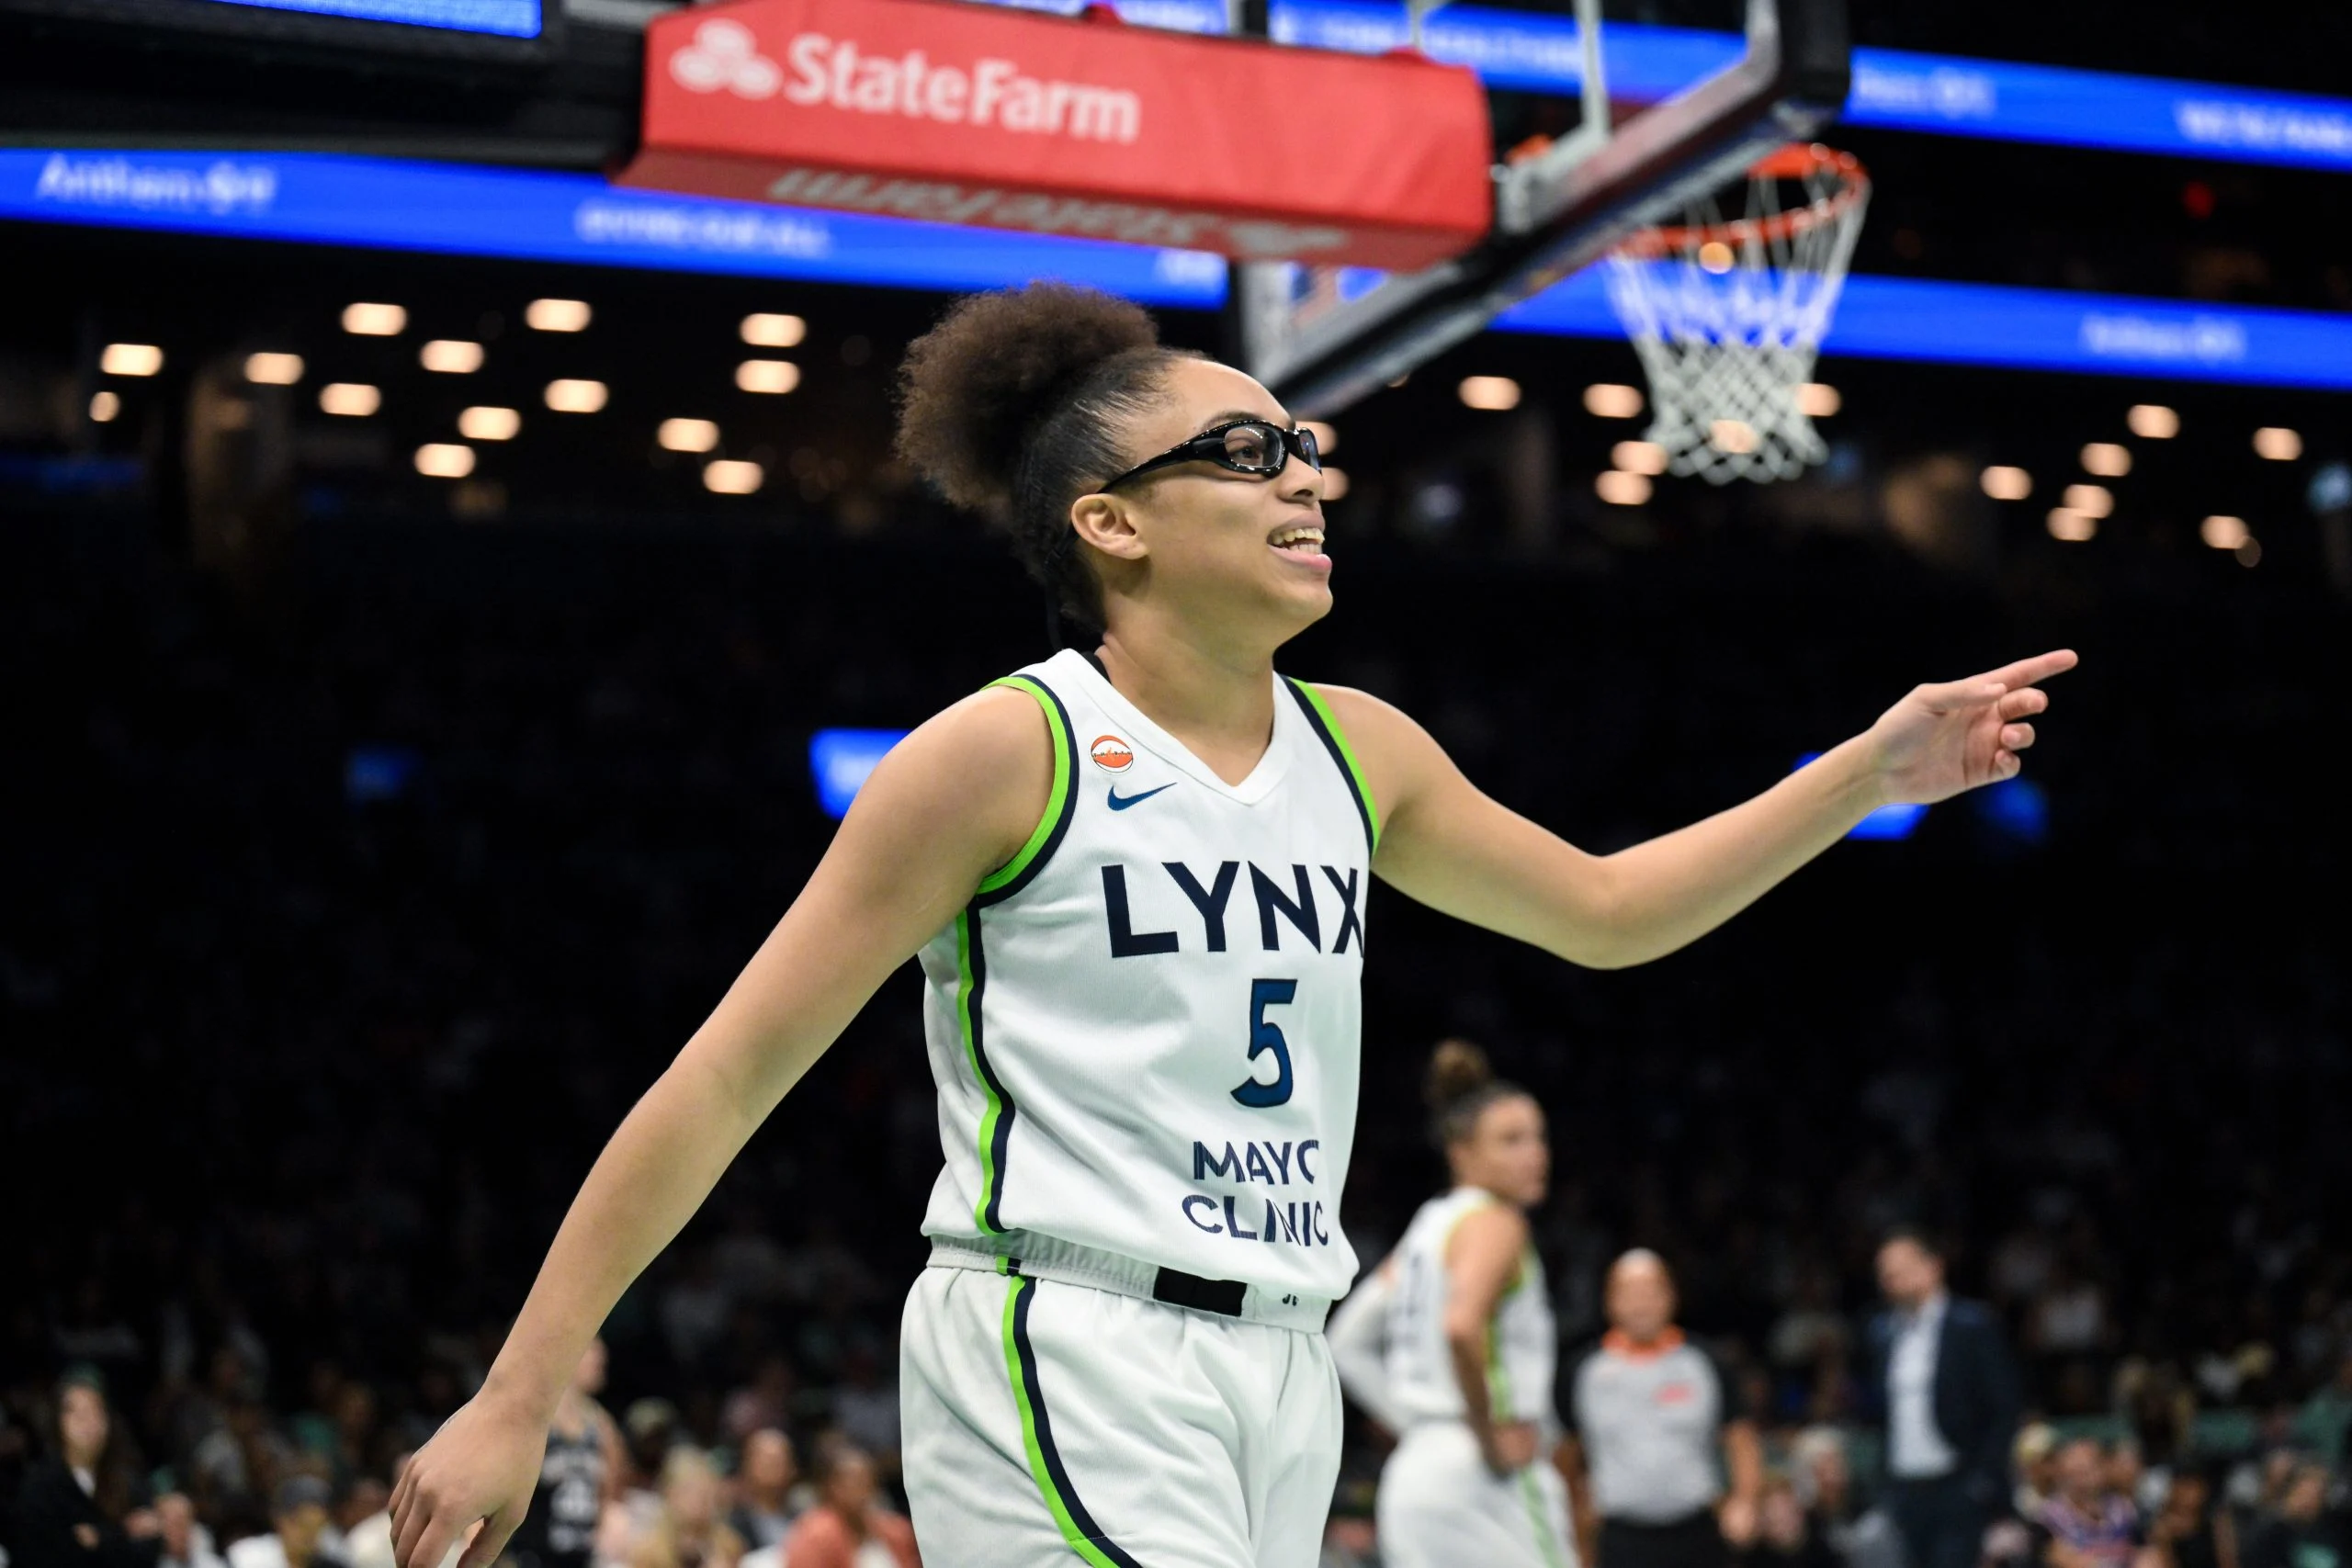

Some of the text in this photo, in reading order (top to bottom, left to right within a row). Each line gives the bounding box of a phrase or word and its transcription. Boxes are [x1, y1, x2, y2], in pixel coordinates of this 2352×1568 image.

[1102, 861, 1364, 958] LYNX
[1230, 978, 1298, 1108] 5
[1182, 1194, 1329, 1247] CLINIC
